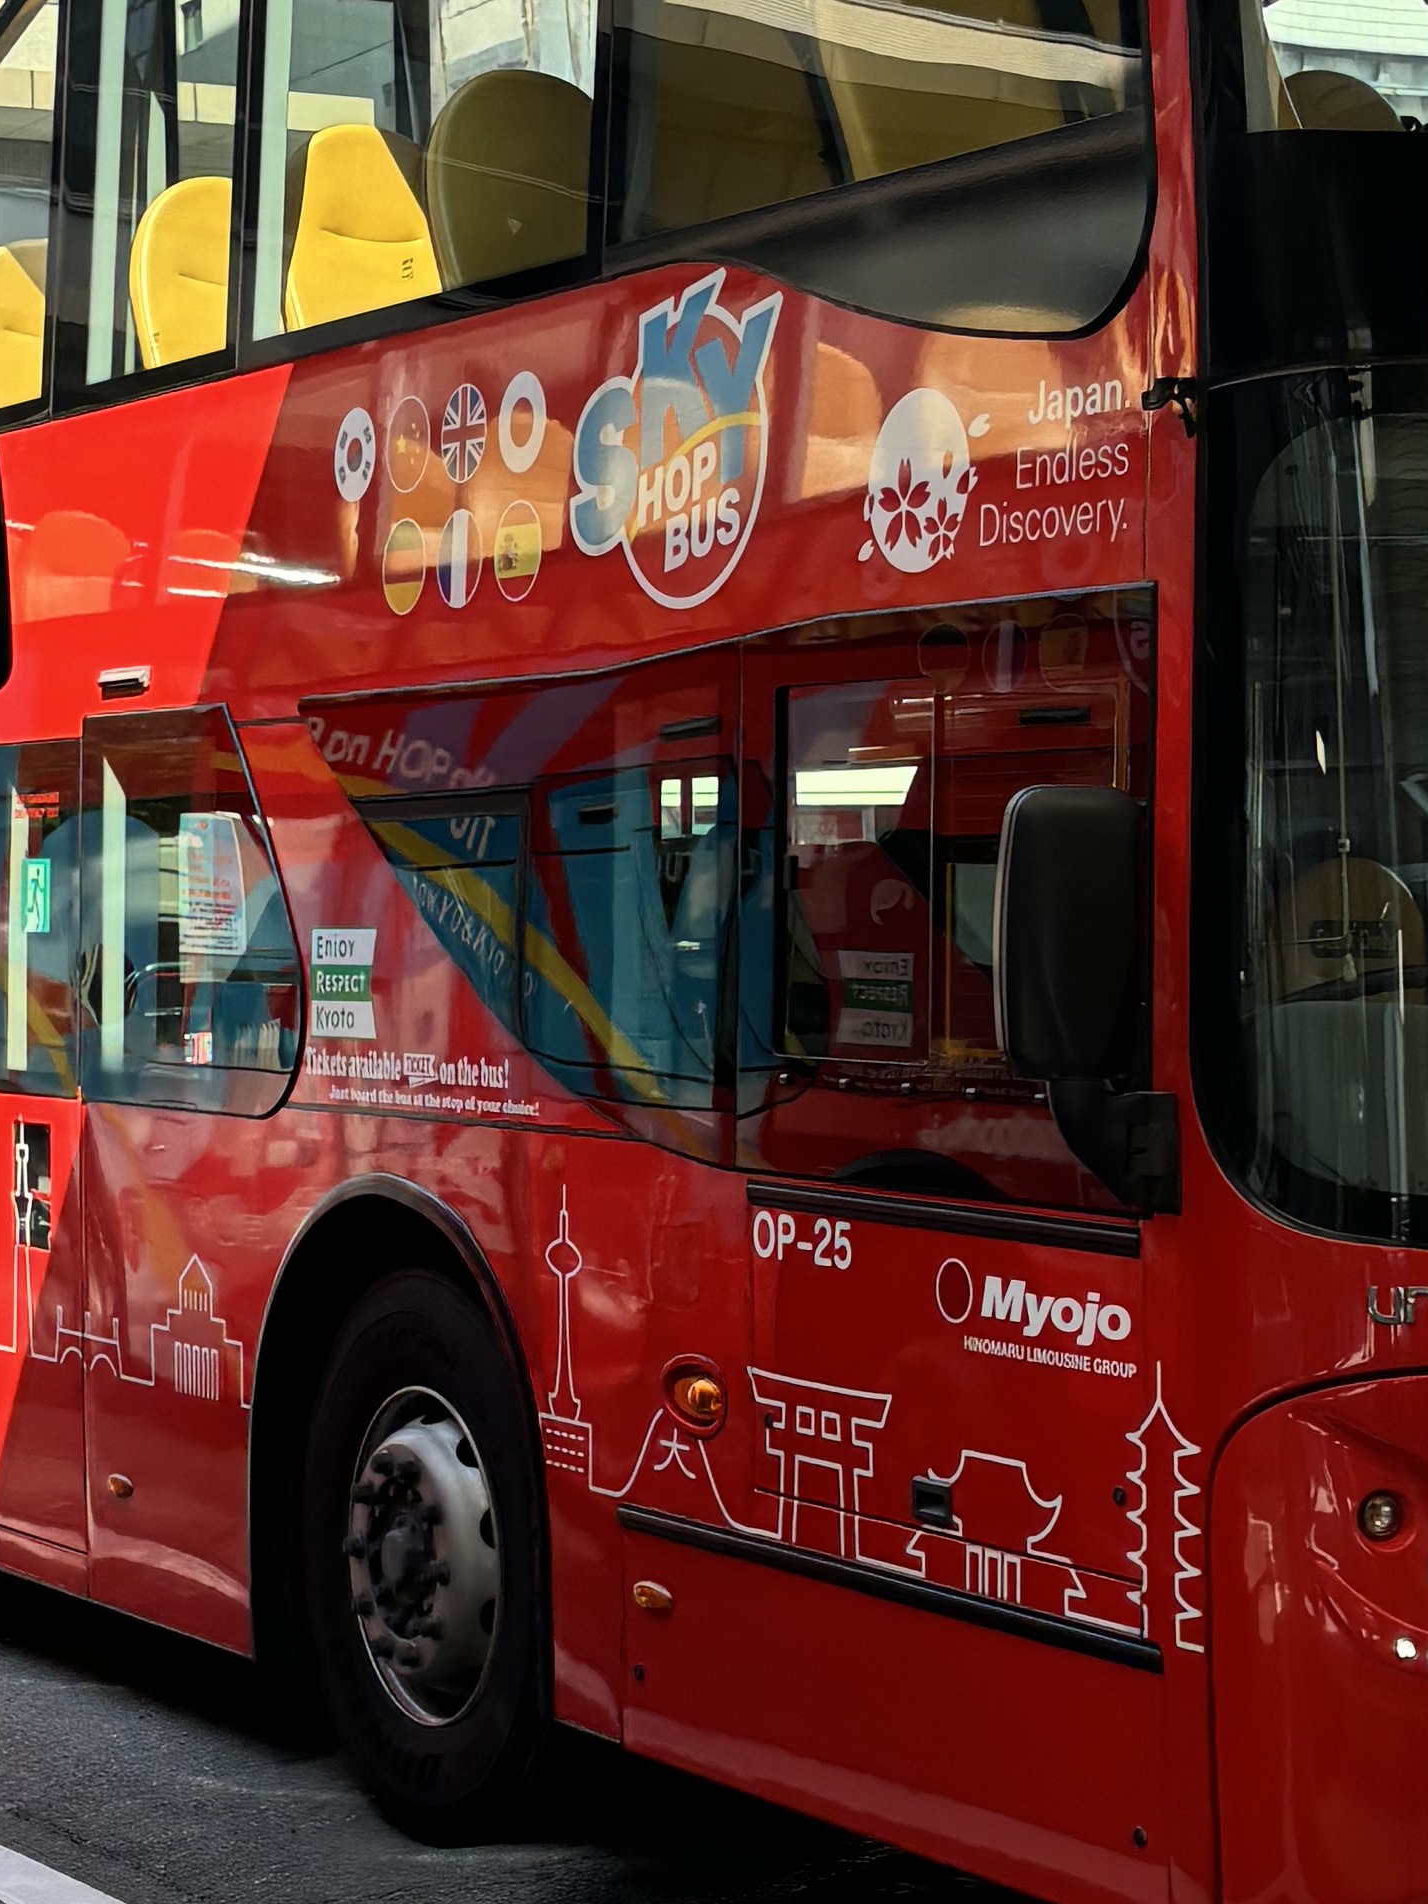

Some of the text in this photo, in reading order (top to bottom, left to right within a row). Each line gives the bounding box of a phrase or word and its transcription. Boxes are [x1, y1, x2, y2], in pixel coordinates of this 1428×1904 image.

[574, 281, 776, 547] SKY
[1028, 379, 1131, 430] Japan.
[638, 442, 717, 528] HOP
[1016, 435, 1129, 489] Endless
[664, 487, 740, 573] BUS
[979, 498, 1128, 546] Discovery.
[316, 1006, 355, 1030] Kyoto
[305, 1046, 347, 1077] Tickets
[348, 1050, 401, 1081] available
[439, 1062, 456, 1086] on
[457, 1056, 479, 1086] the
[480, 1057, 509, 1089] bus!
[752, 1210, 852, 1270] OP-25
[981, 1276, 1132, 1346] Myojo
[963, 1335, 1137, 1378] HINOMARU LIMOUSINE GROUP
